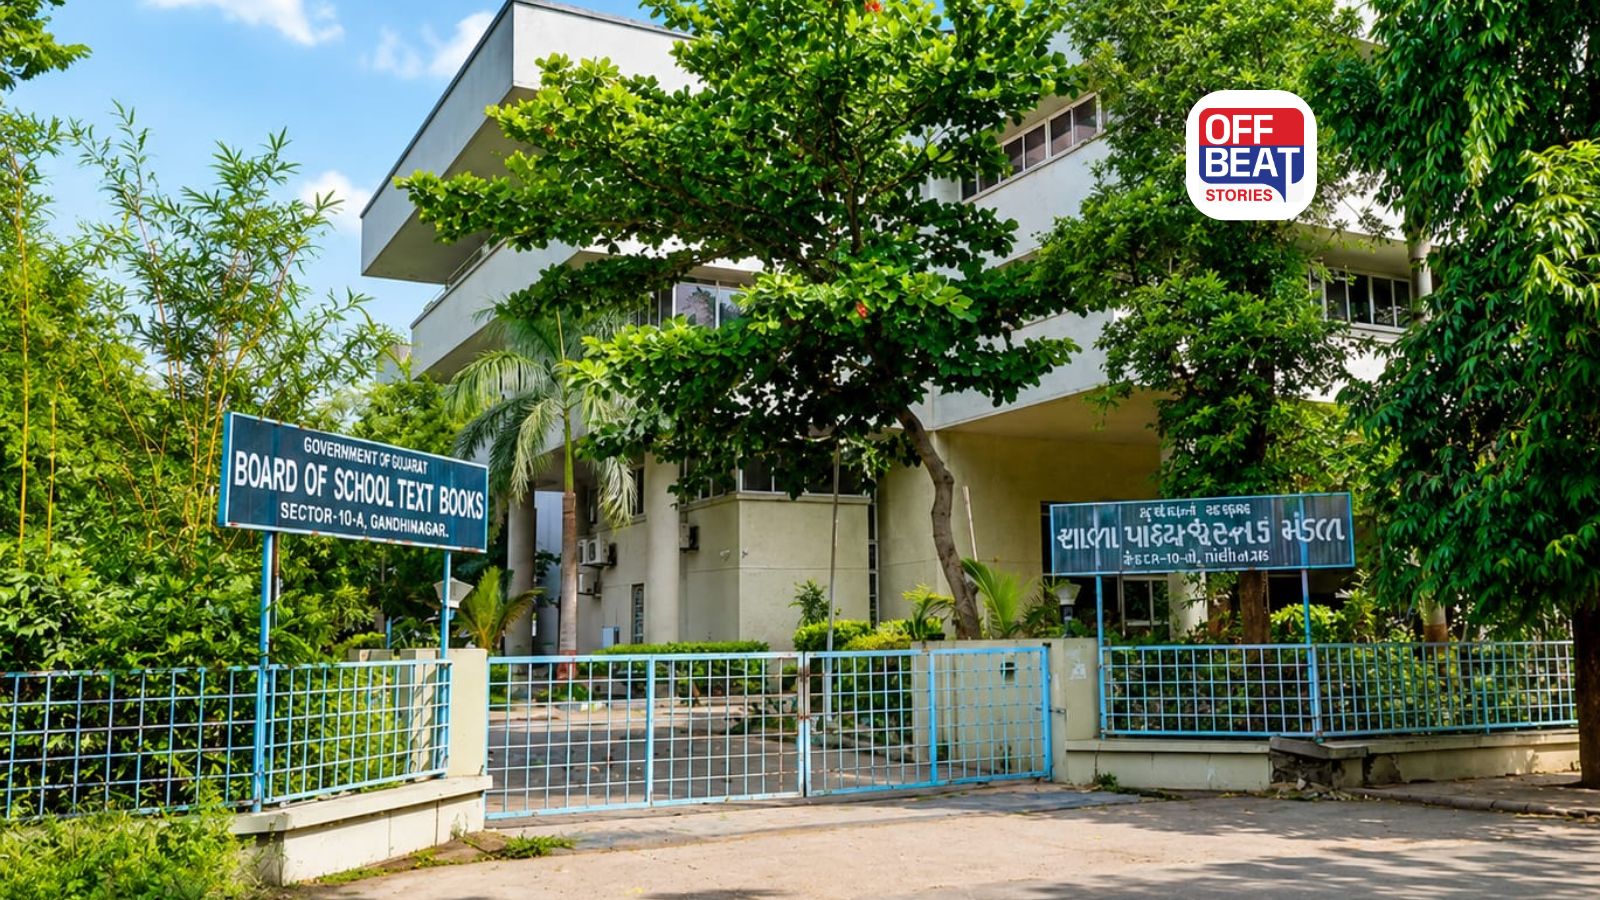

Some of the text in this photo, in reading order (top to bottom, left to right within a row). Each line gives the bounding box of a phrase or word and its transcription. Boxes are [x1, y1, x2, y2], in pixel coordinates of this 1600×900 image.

[304, 436, 429, 475] GOVERNMENT OF GUJARAT
[234, 450, 484, 520] BOARD OF SCHOOL TEXT BOOKS
[280, 501, 450, 538] SECTOR-10-A, GANDHINAGAR.
